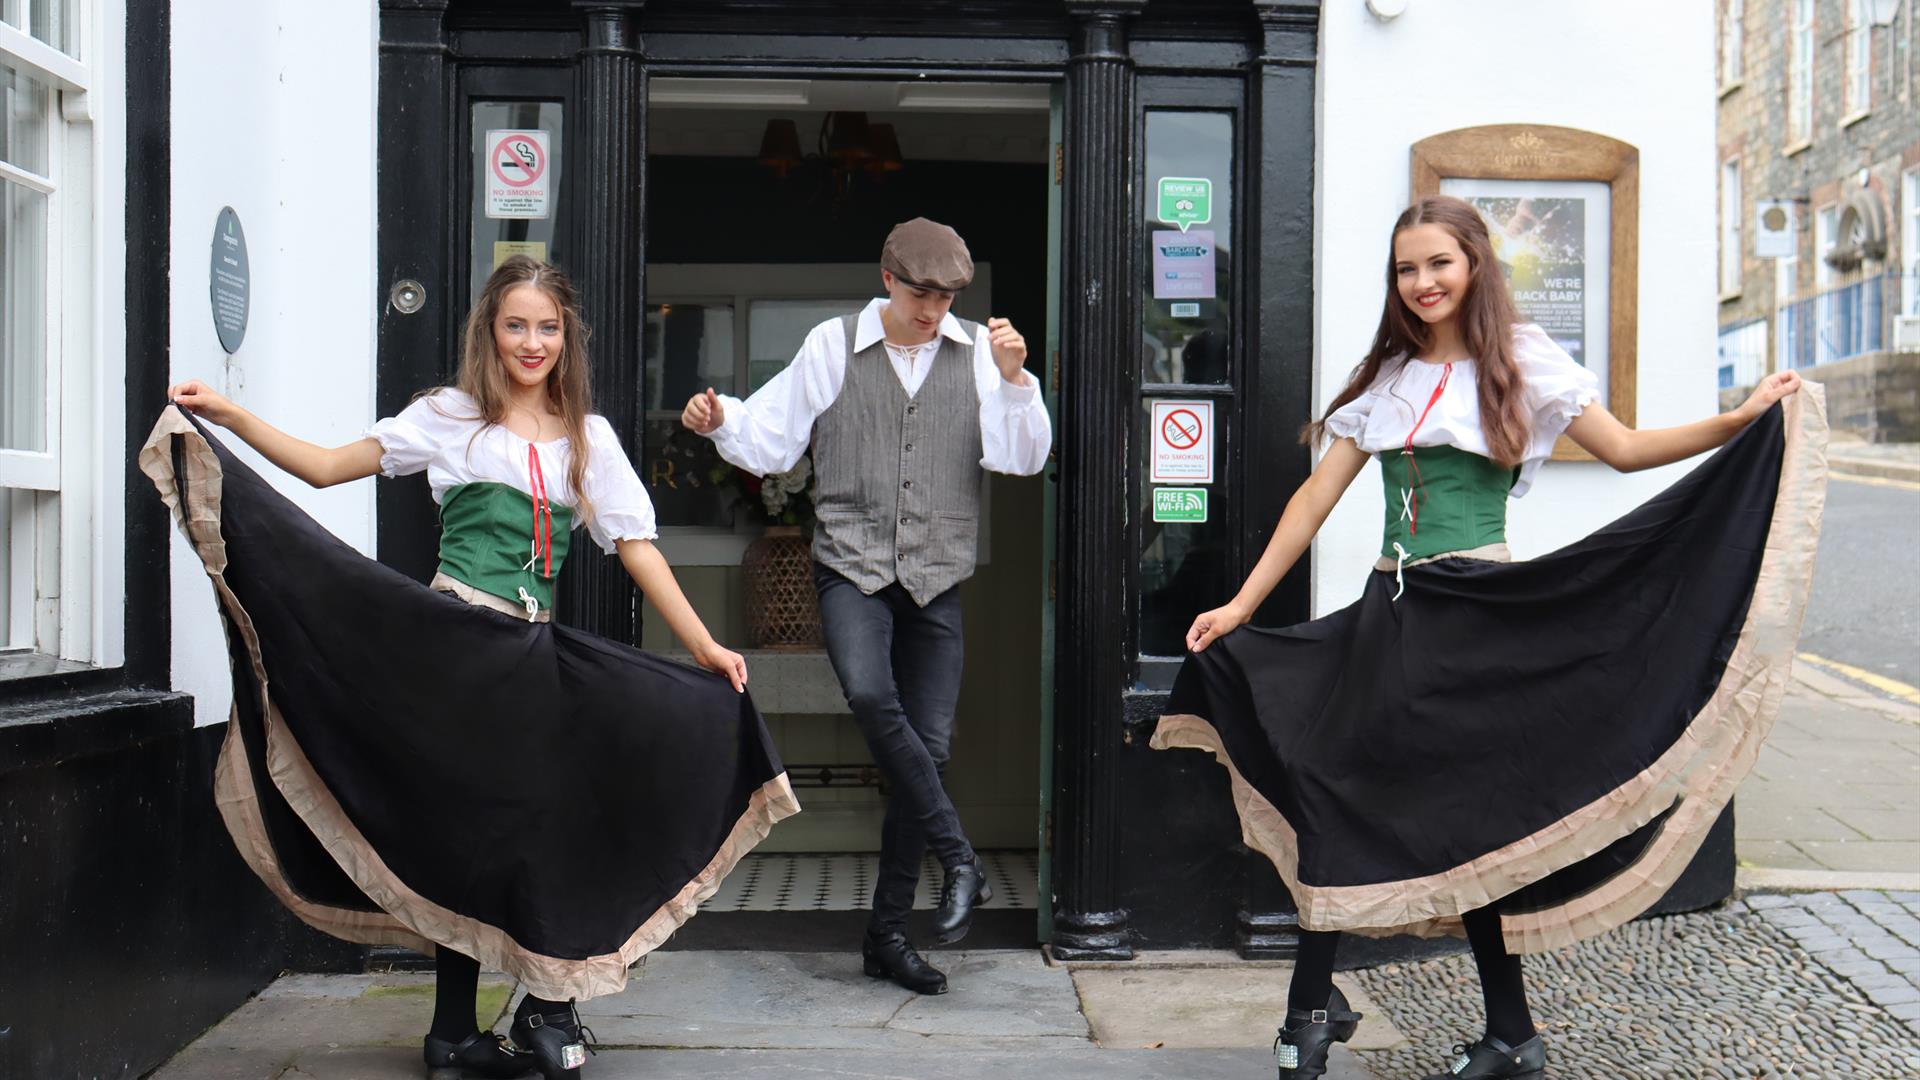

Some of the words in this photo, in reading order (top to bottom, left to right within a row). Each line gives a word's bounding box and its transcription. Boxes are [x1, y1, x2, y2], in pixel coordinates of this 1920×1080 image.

[1164, 184, 1193, 193] REVIEW
[1544, 278, 1581, 288] WE'RE
[1514, 291, 1547, 301] BACK
[1550, 291, 1582, 301] BABY
[1157, 492, 1184, 502] FREE
